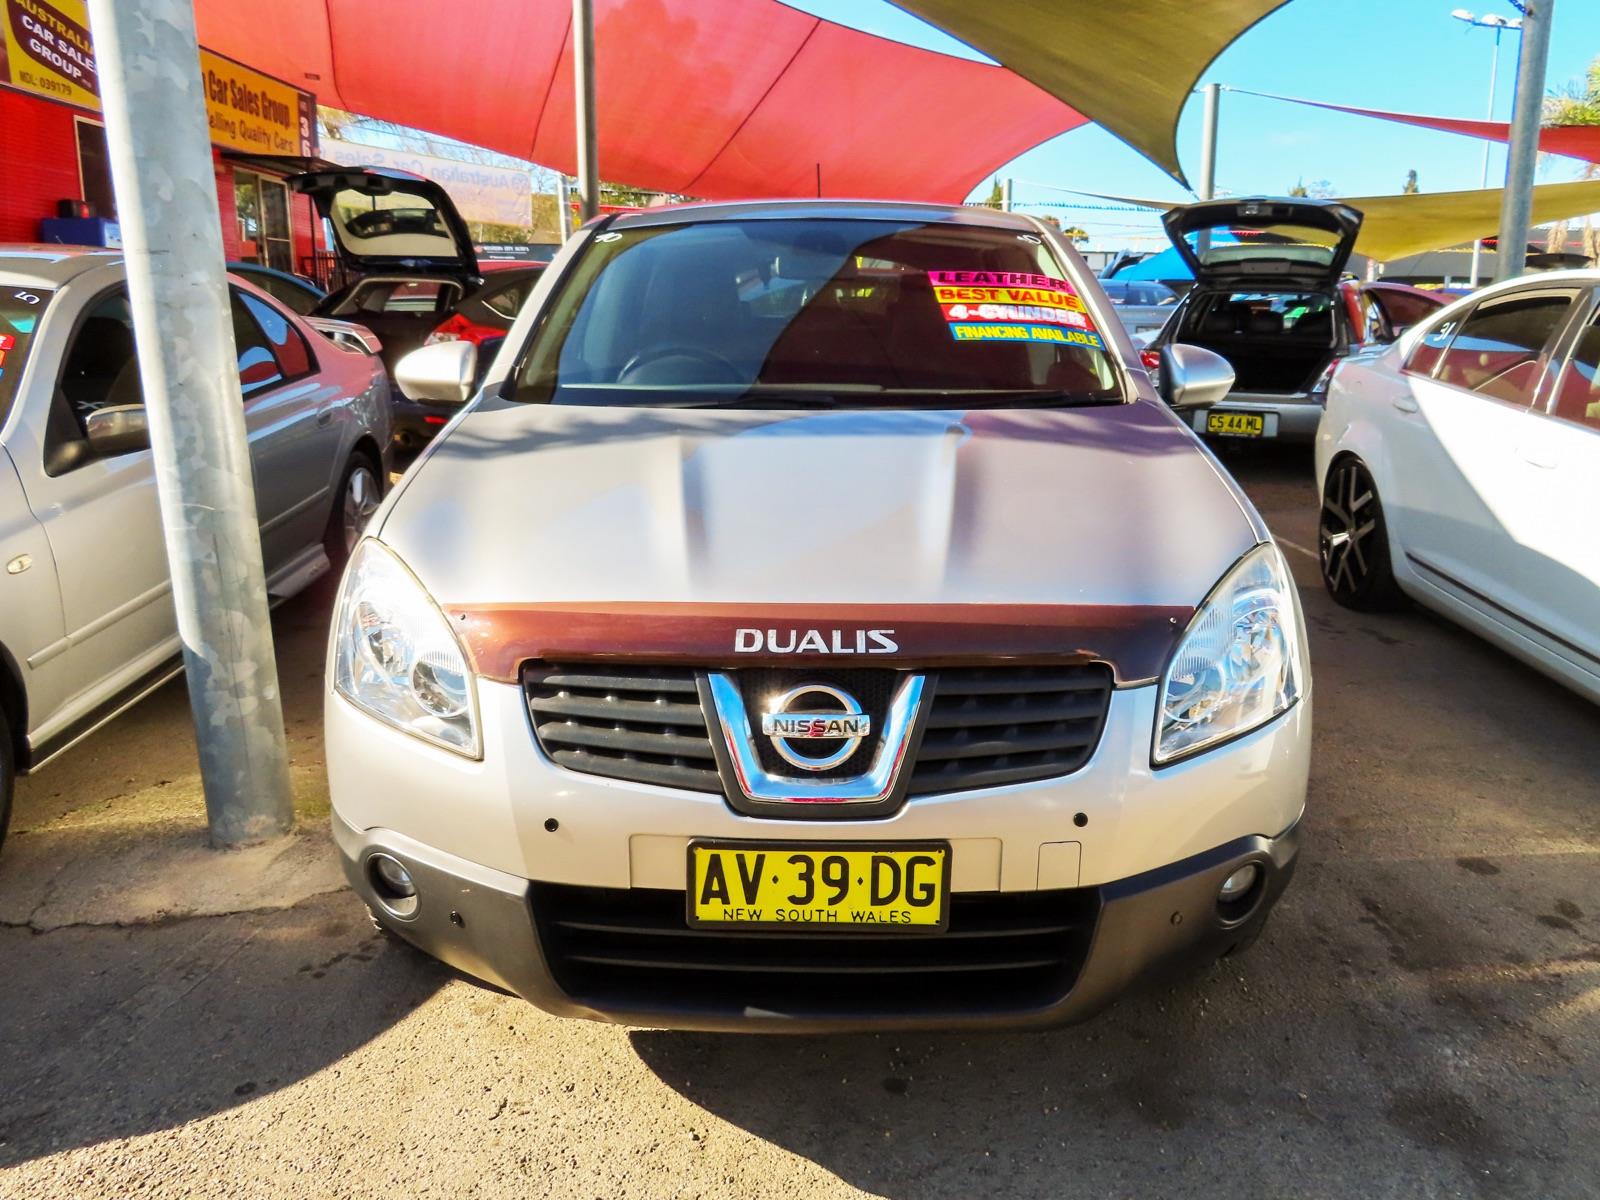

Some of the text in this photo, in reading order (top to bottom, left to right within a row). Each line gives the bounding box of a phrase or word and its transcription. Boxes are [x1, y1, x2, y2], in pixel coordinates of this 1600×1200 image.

[22, 15, 97, 73] CAR SALE
[30, 38, 82, 78] GROUP
[208, 69, 228, 106] Car
[230, 78, 260, 117] Sales
[261, 89, 290, 131] Group
[207, 109, 294, 153] elling Quality Cars
[938, 272, 1067, 290] LEATHER
[939, 289, 1079, 308] BEST VALUE
[955, 325, 1102, 348] FINANCING AVAILABLE
[734, 628, 899, 654] DUALIS
[773, 719, 860, 733] NISSAN
[723, 908, 912, 924] NEW SOUTH WALES
